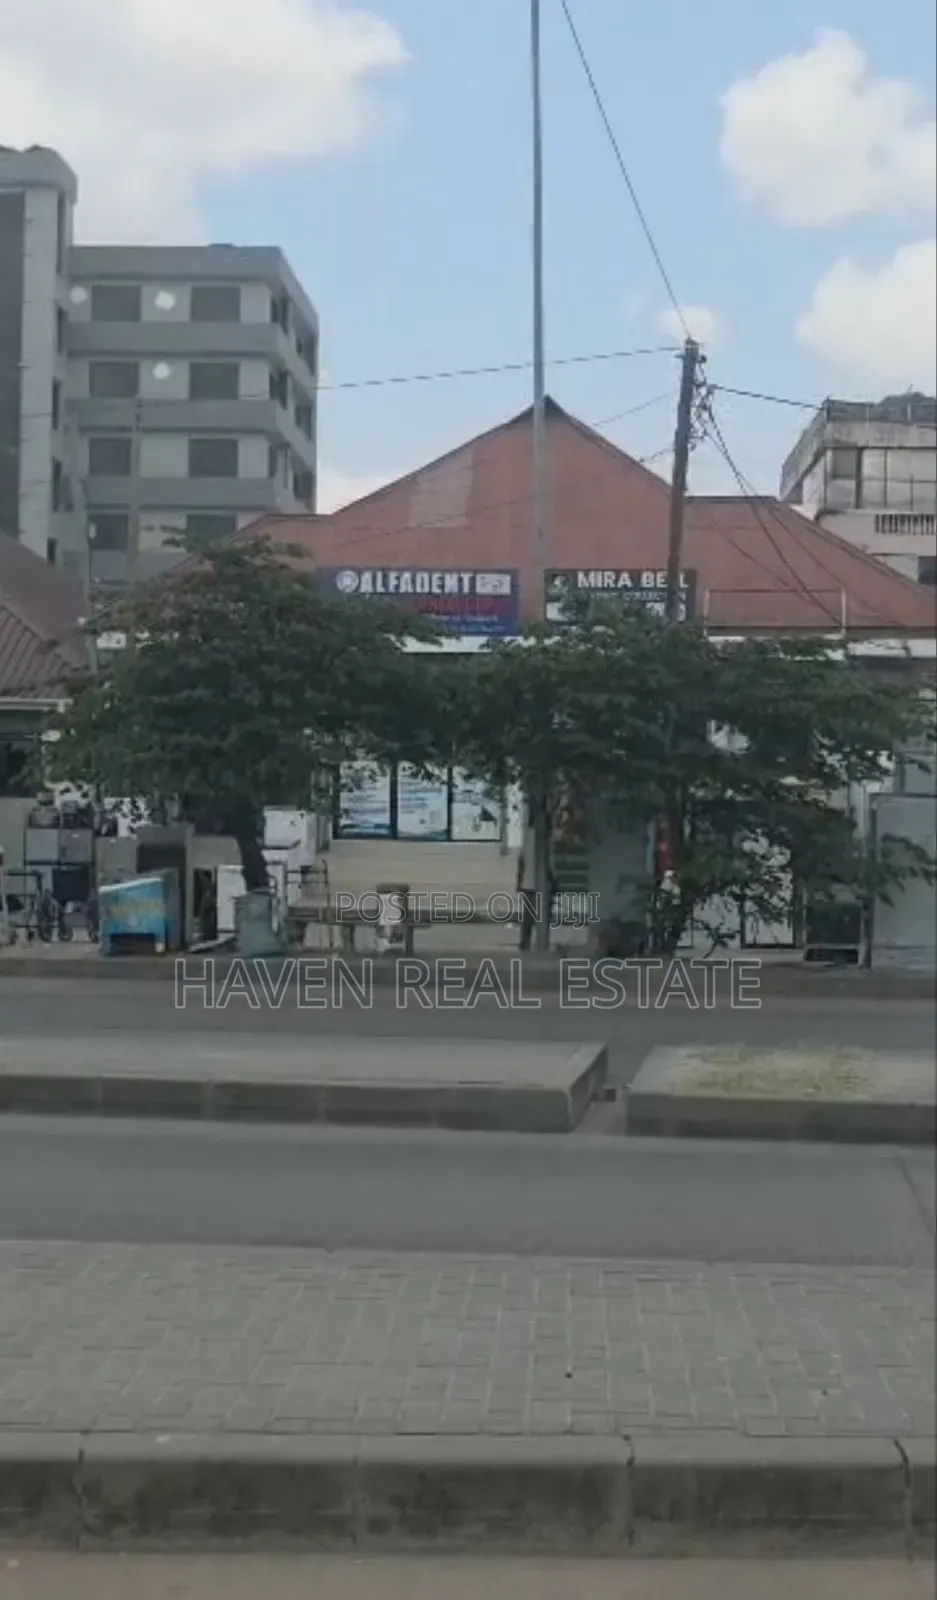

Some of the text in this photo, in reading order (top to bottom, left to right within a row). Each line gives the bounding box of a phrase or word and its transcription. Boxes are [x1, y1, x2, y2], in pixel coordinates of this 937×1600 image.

[359, 569, 475, 594] ALFADENT
[576, 570, 689, 588] MIRA BEL
